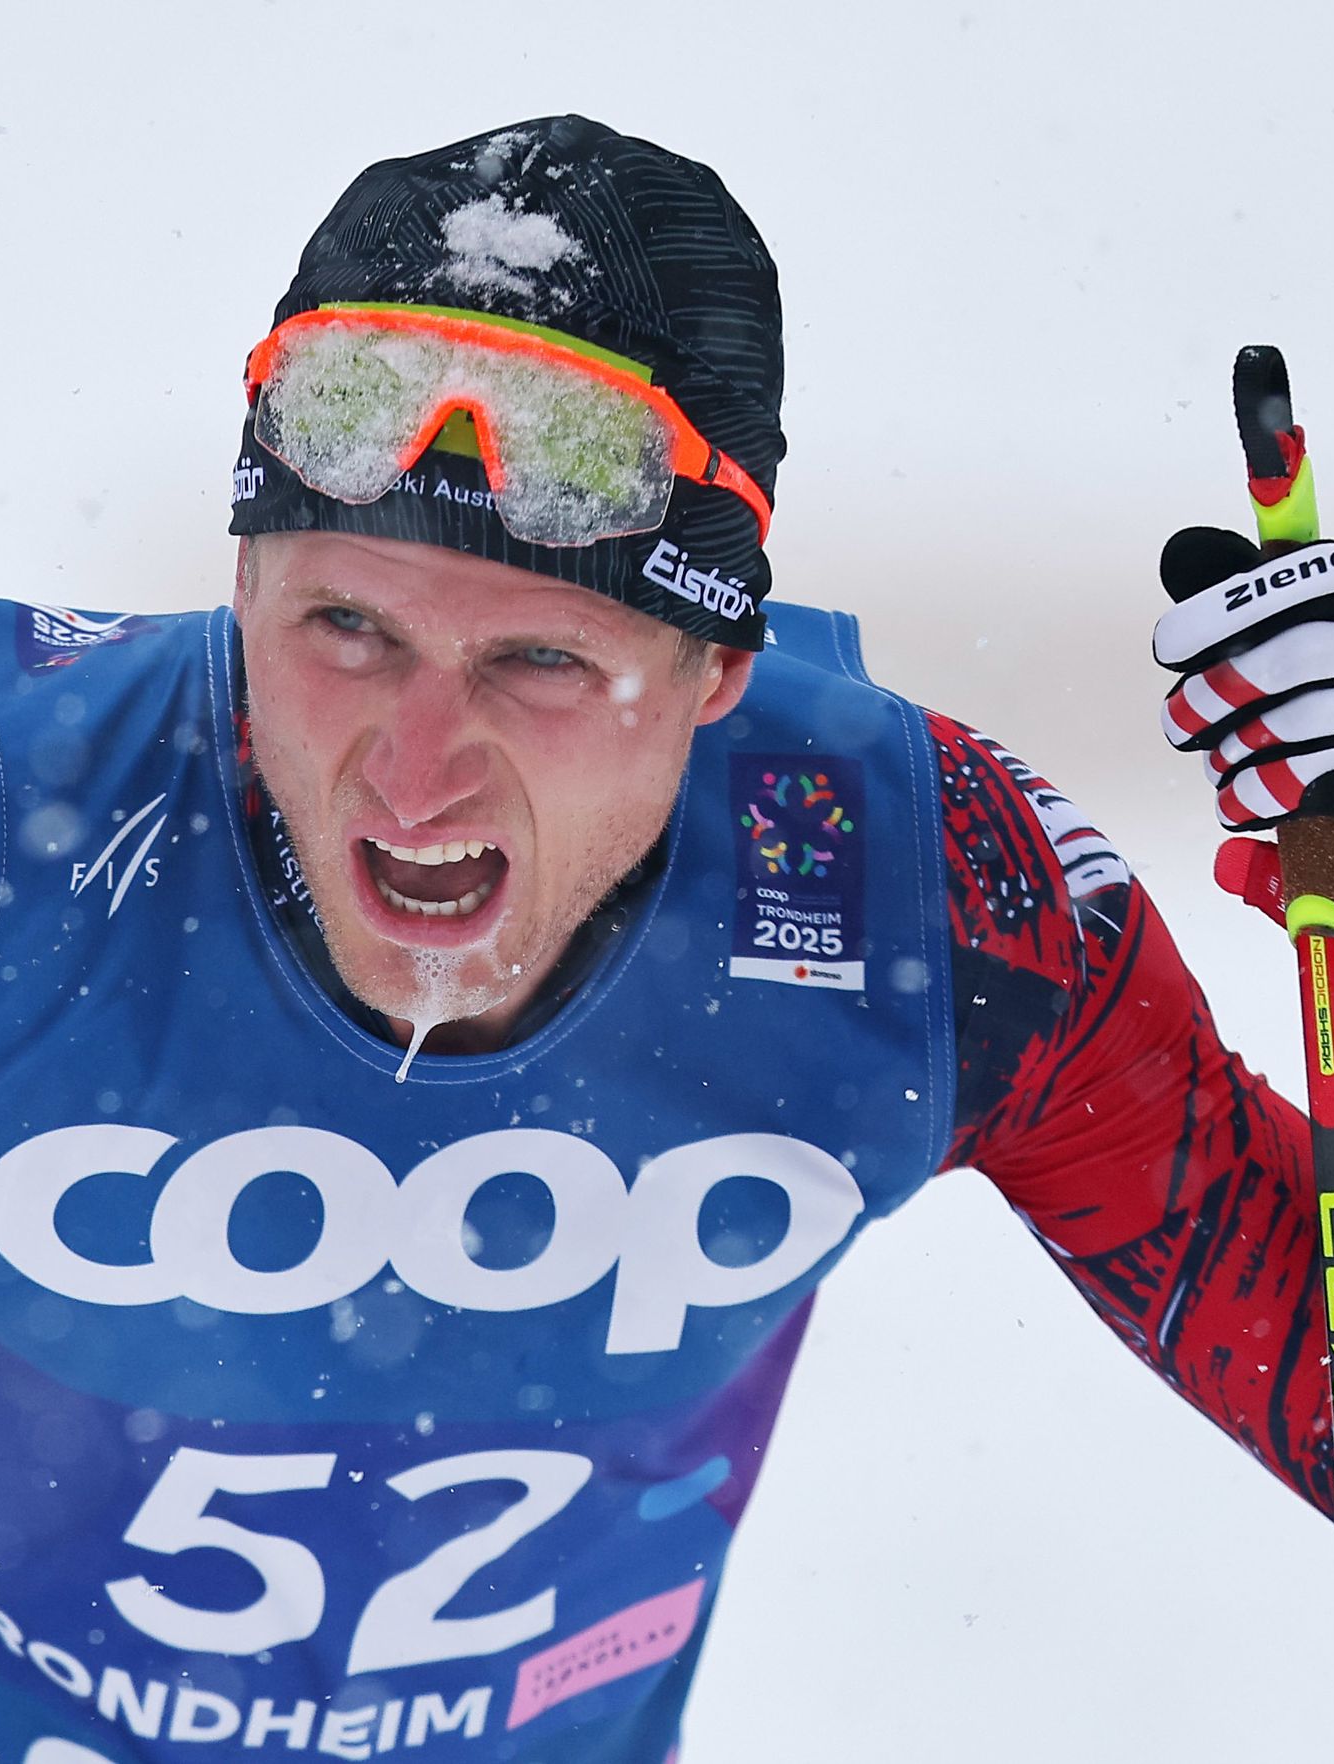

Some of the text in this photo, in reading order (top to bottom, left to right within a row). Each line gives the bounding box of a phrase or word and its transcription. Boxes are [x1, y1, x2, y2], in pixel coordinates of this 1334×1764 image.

[755, 887, 789, 902] coop
[756, 904, 842, 925] TRONDHEIM
[753, 920, 843, 956] 2025
[1312, 938, 1333, 1070] NORDIC SHARK
[104, 1446, 595, 1676] 52
